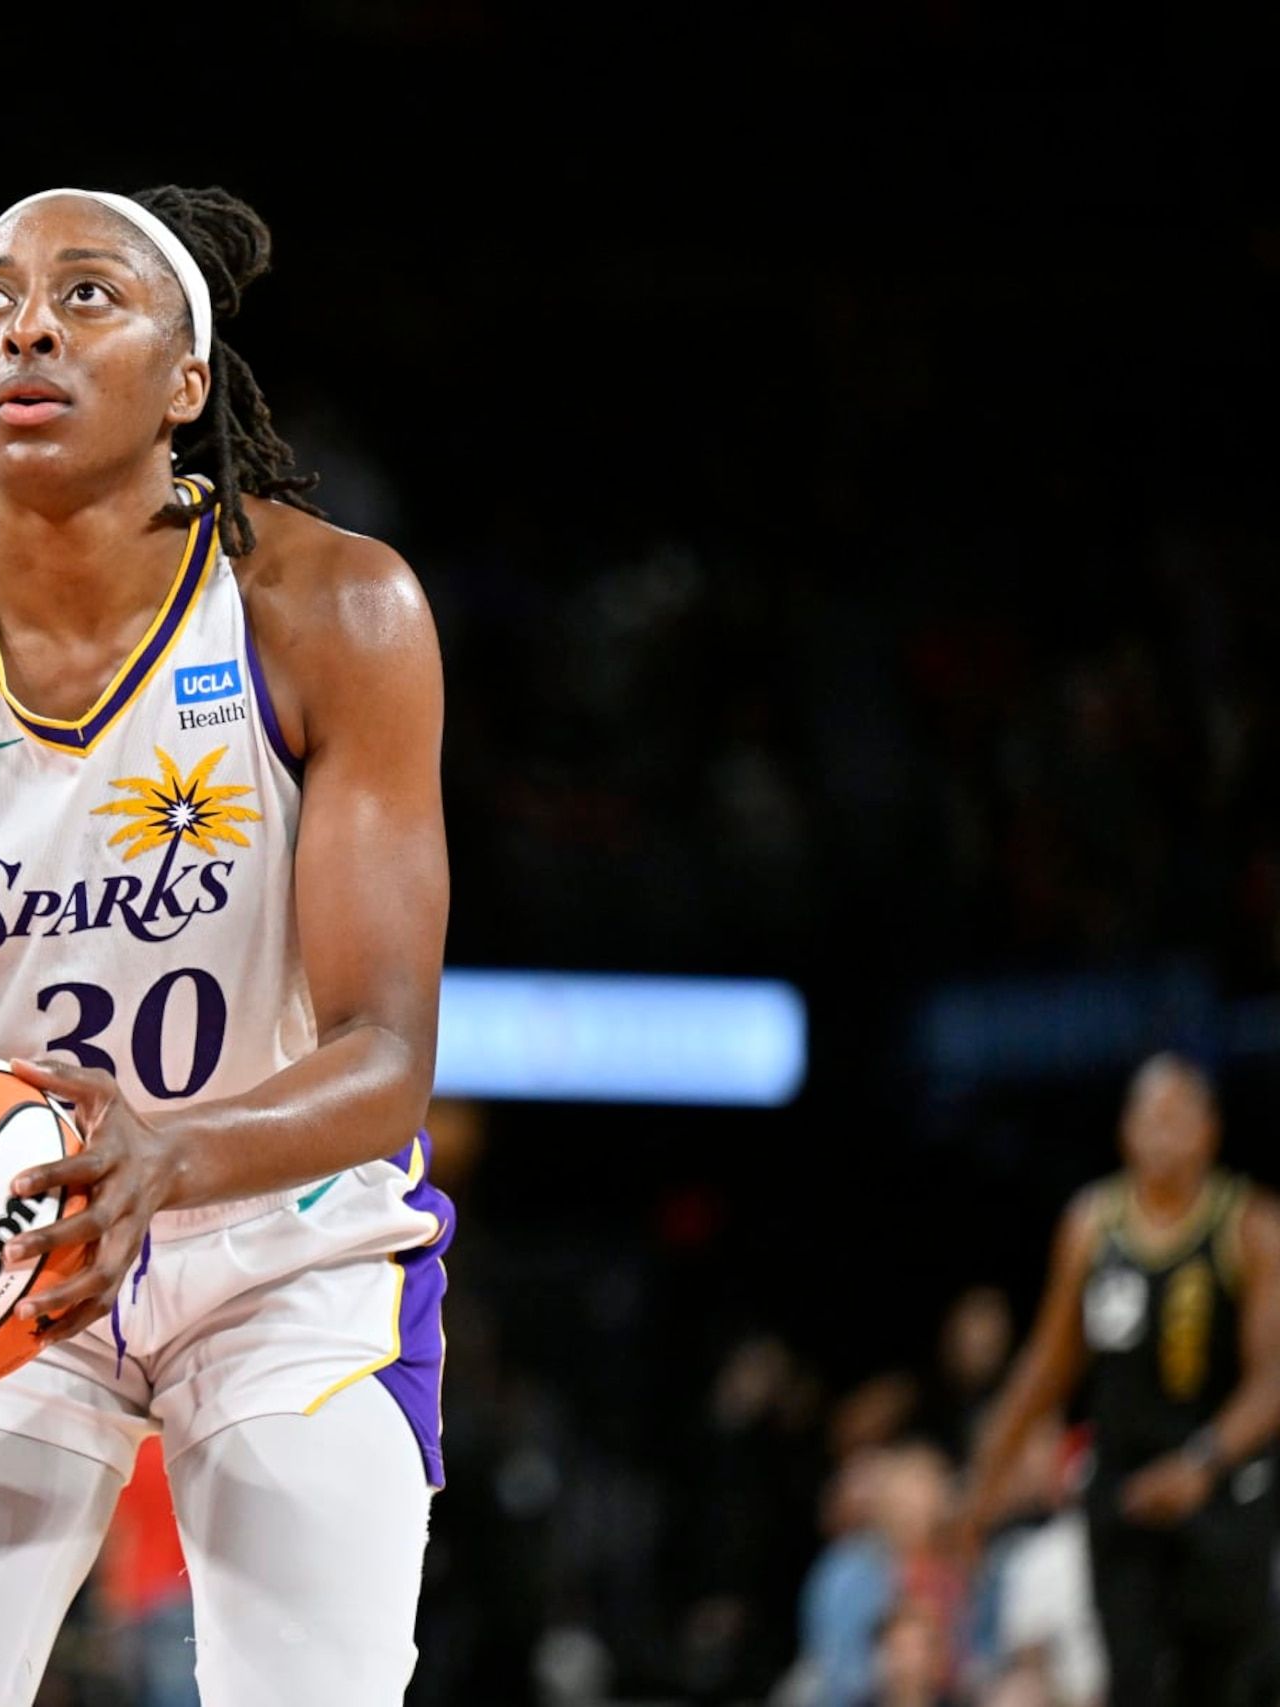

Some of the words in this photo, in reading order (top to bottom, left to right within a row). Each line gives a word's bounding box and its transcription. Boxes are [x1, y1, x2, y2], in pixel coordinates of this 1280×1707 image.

[183, 671, 234, 695] UCLA
[178, 702, 245, 730] Health
[37, 968, 227, 1109] 30
